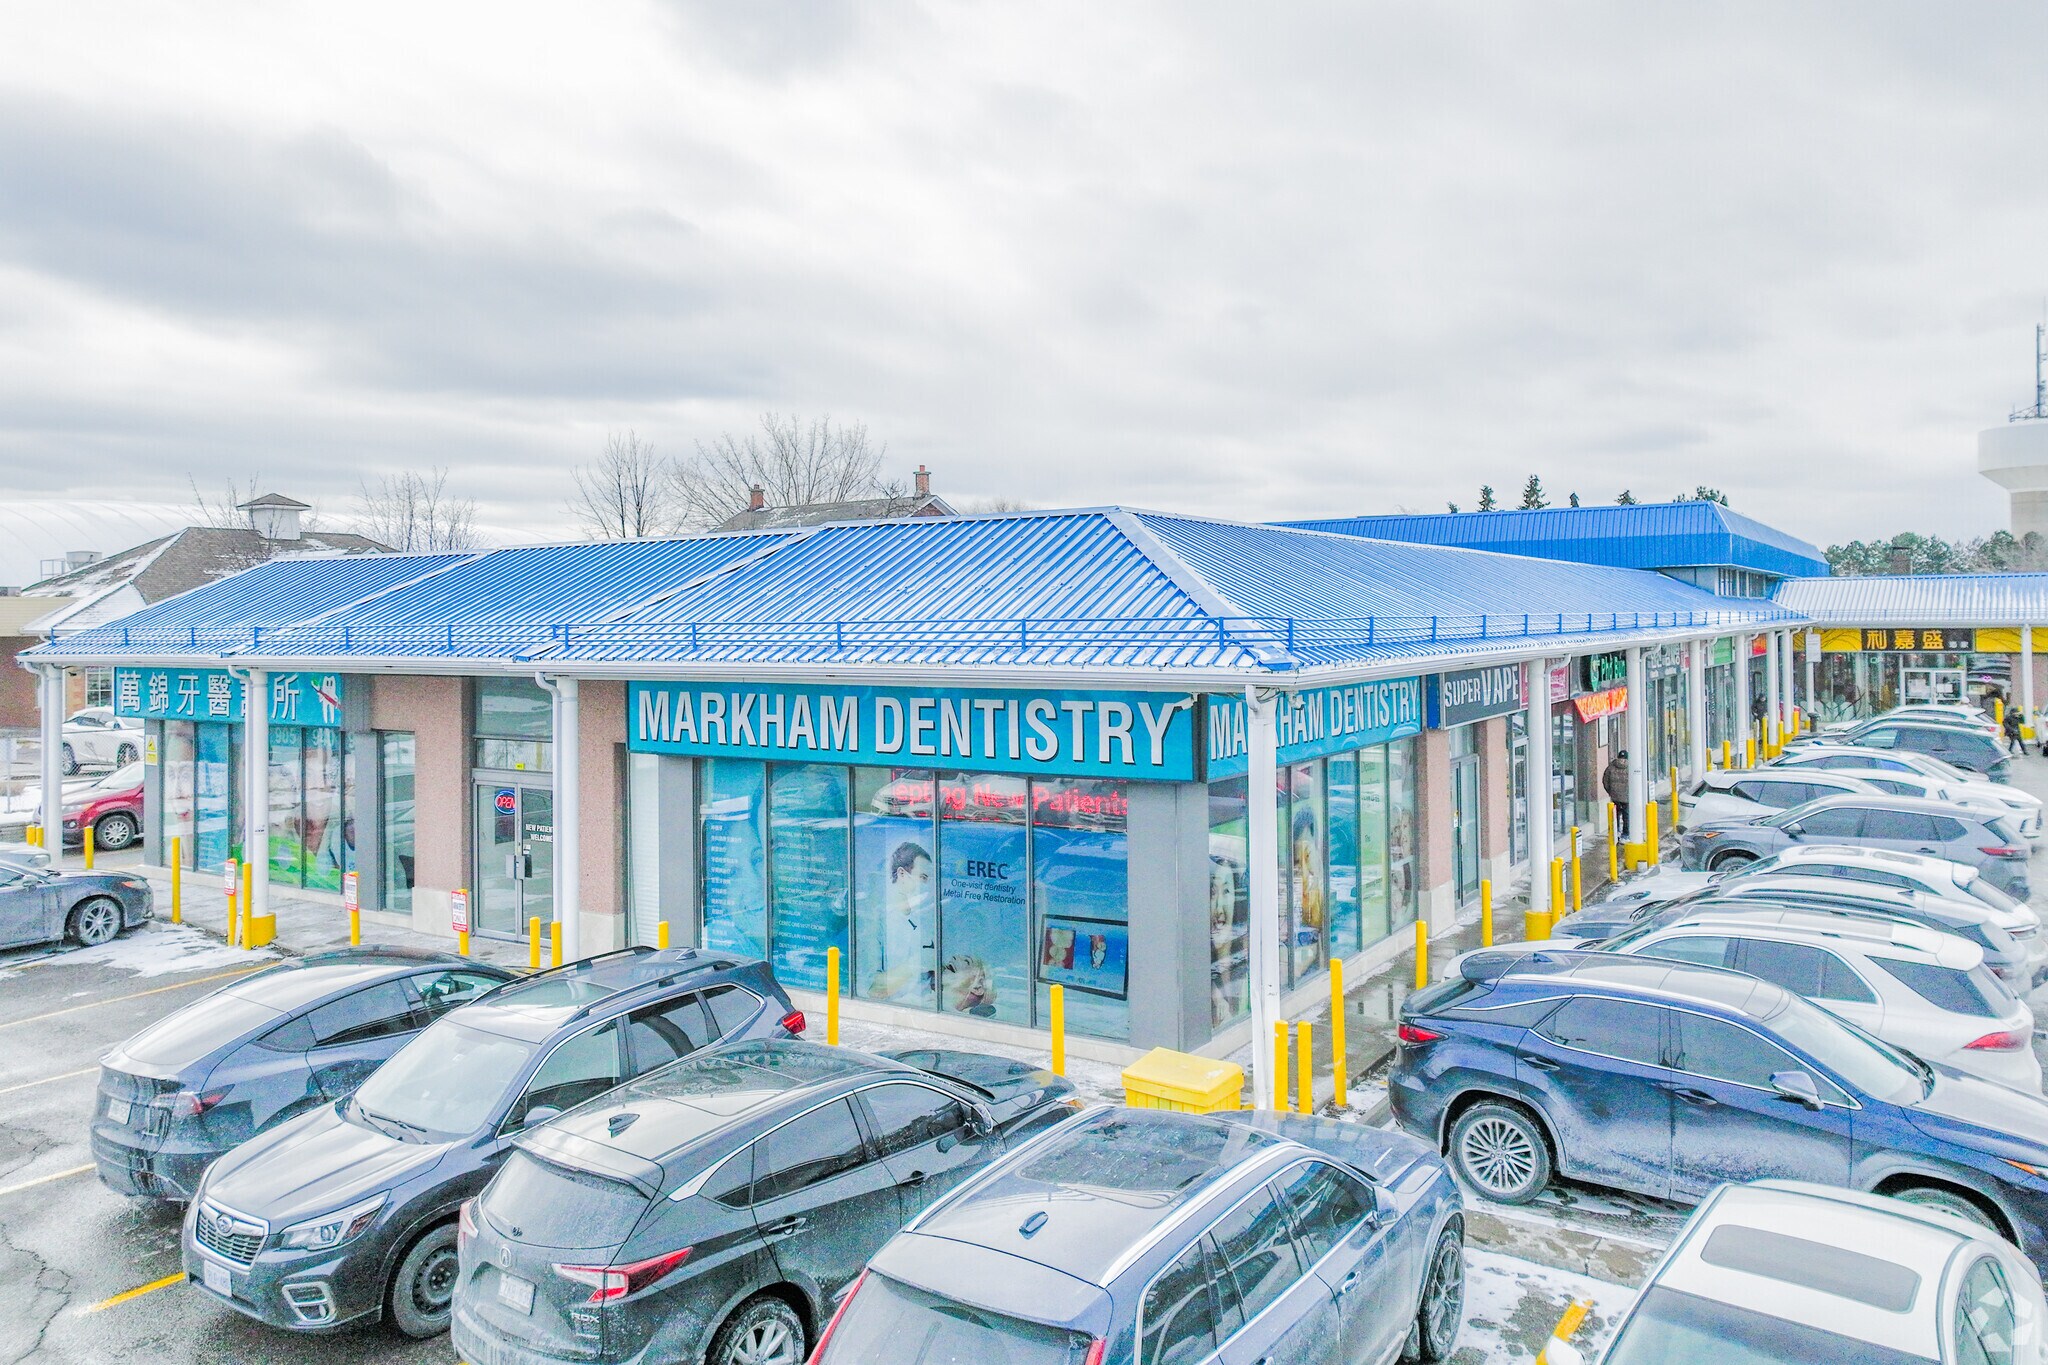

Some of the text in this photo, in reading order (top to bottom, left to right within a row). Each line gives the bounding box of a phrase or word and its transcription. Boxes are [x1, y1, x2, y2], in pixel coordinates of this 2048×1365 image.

[1445, 678, 1480, 707] SUPER
[1481, 665, 1519, 706] VAPE
[638, 690, 1177, 766] MARKHAM DENTISTRY
[1210, 679, 1419, 761] MAHAM DENTISTRY
[973, 782, 1025, 809] New
[943, 889, 1026, 905] Metal Free Restoration
[951, 879, 1016, 895] One-visit dentistry
[571, 1312, 600, 1324] RDX
